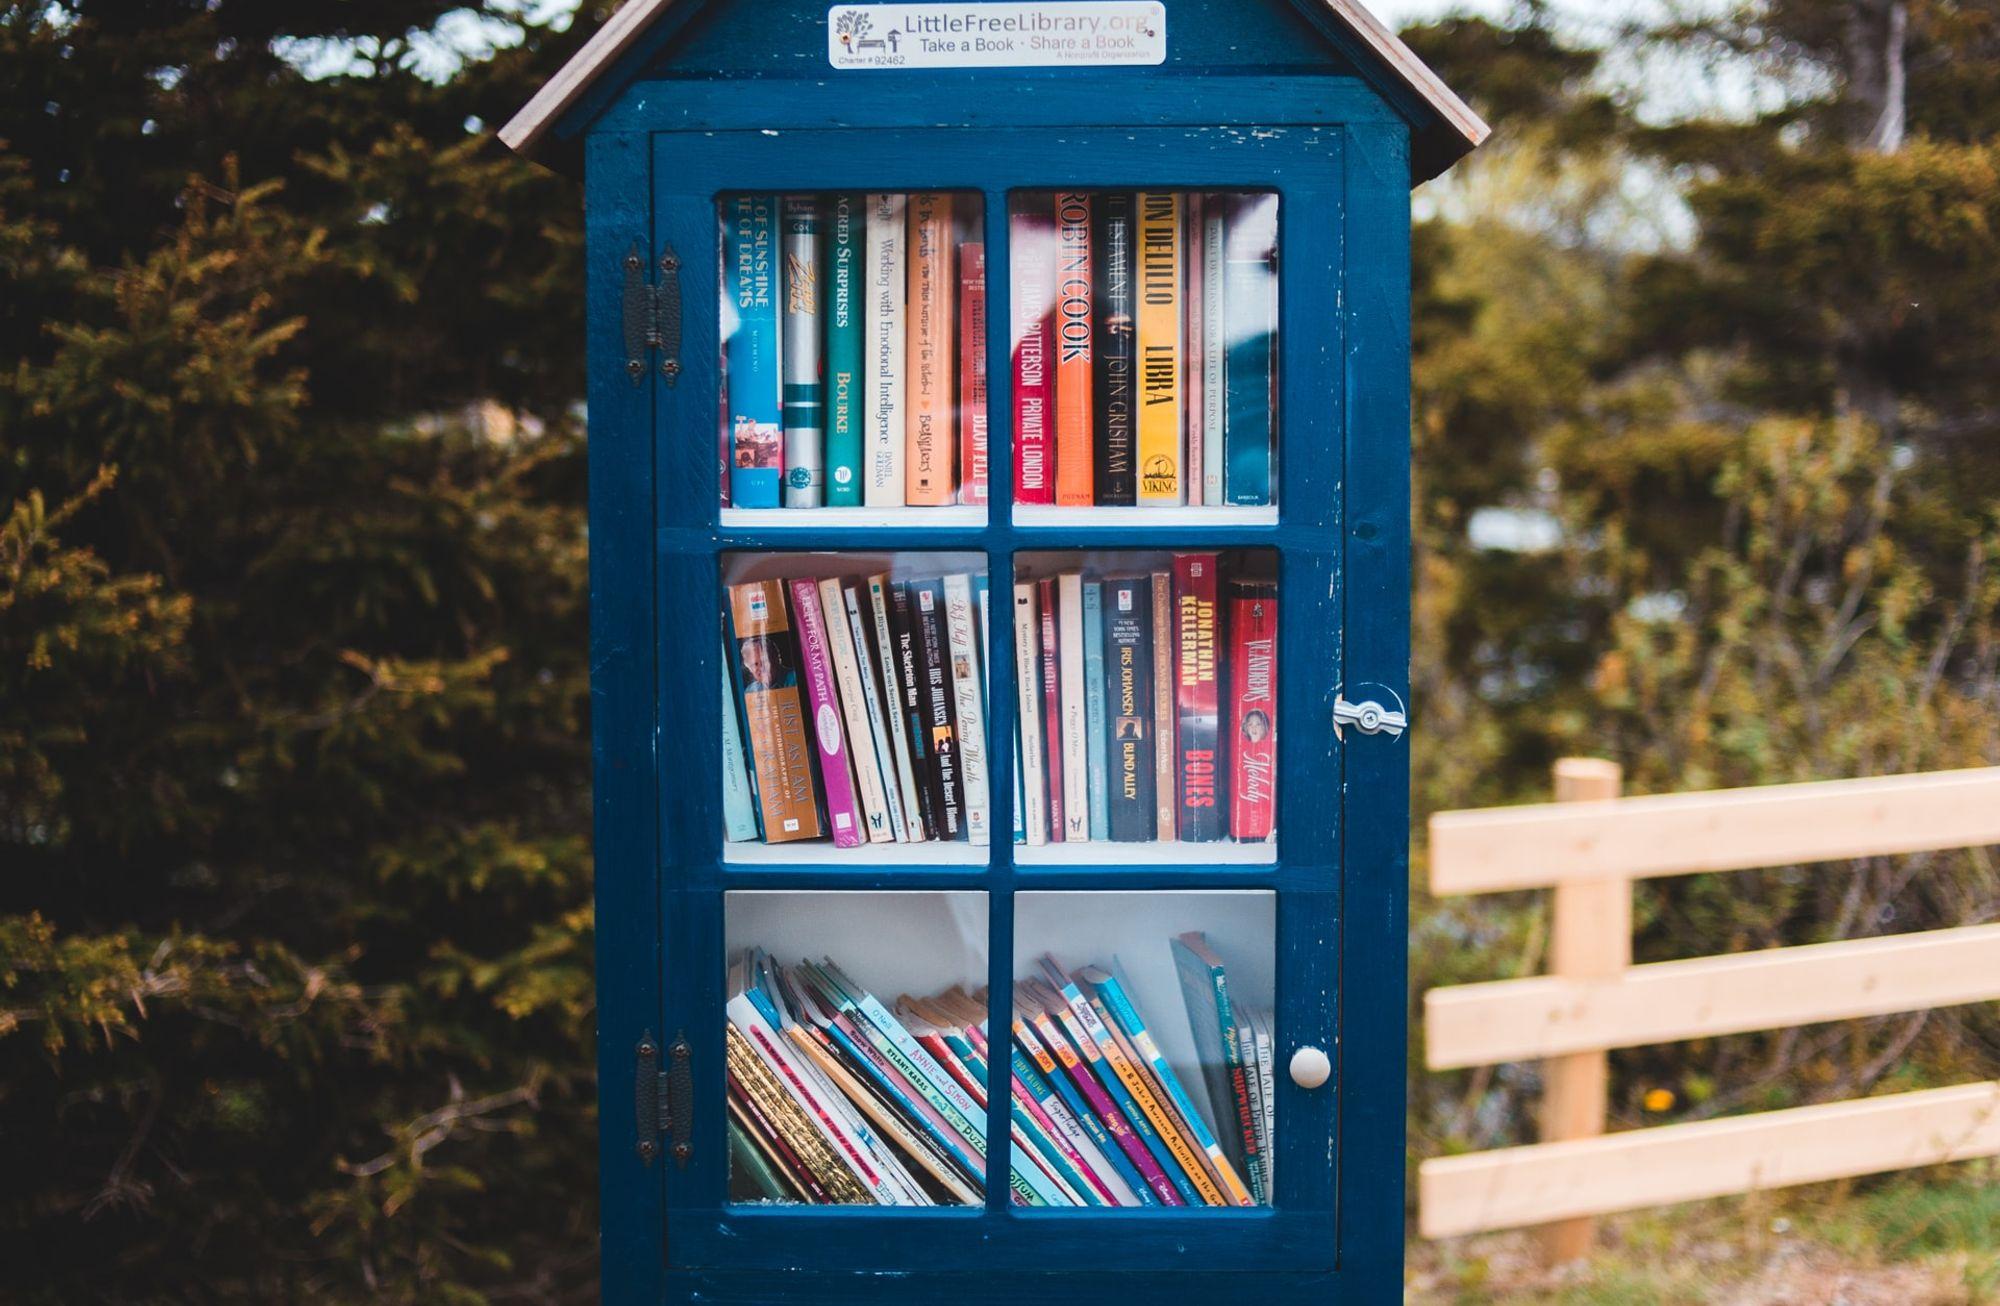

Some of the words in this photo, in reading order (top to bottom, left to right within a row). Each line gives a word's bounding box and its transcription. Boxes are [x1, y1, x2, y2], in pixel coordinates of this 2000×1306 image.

[905, 13, 1148, 34] LittleFreeLibrary.org
[838, 56, 867, 65] Charter
[874, 55, 905, 66] 92462
[920, 38, 955, 53] Take
[960, 42, 970, 52] a
[975, 36, 1014, 52] Book
[1030, 36, 1070, 50] Share
[1075, 40, 1085, 50] a
[1096, 35, 1135, 49] Book
[1060, 193, 1091, 273] ROBIN
[739, 243, 753, 308] DREAMS
[875, 239, 895, 287] Working
[1144, 228, 1174, 305] DELILLO
[836, 247, 852, 328] SURPRISES
[879, 290, 894, 317] with
[1060, 279, 1092, 364] COOK
[879, 321, 895, 379] Emotional
[1021, 321, 1043, 387] PATTERSON
[1104, 355, 1129, 396] JOHN
[1145, 346, 1174, 407] LIBRA
[836, 371, 852, 434] BOURKE
[875, 382, 894, 444] Intelligence
[1021, 398, 1043, 441] PRIVATE
[1109, 401, 1129, 473] GRISHAM
[1022, 443, 1043, 490] LONDON
[1142, 481, 1177, 493] VIKING
[806, 629, 819, 652] FOR
[899, 631, 912, 649] The
[1121, 646, 1133, 665] IRIS
[1182, 595, 1197, 686] KELLERMAN
[1198, 600, 1214, 681] JONATHAN
[810, 652, 822, 672] MY
[900, 649, 917, 687] Skeleton
[928, 666, 943, 685] IRIS
[813, 672, 828, 702] PATH
[907, 688, 918, 706] Man
[929, 685, 948, 726] JOHANSEN
[1121, 665, 1135, 715] JOHANSEN
[957, 710, 979, 744] Penny
[1123, 742, 1135, 770] BLIND
[942, 780, 956, 805] Desert
[1124, 771, 1136, 800] ALLEY
[1184, 750, 1214, 807] BONES
[1240, 751, 1272, 803] Melody
[1240, 1039, 1252, 1057] THE
[1258, 1044, 1270, 1066] THE
[908, 1046, 938, 1077] ANNIE
[943, 1082, 973, 1113] SIMON
[1244, 1063, 1257, 1089] TALE
[1261, 1072, 1273, 1100] TALE
[1232, 1067, 1257, 1155] SHIPWRECKED
[1248, 1091, 1259, 1106] OF
[1130, 1078, 1152, 1104] Jake's
[1146, 1102, 1174, 1137] Awesome
[1168, 1134, 1198, 1171] Activities
[1193, 1170, 1202, 1181] on
[1200, 1180, 1213, 1194] the
[1252, 1108, 1264, 1141] PETER
[1257, 1145, 1270, 1185] RABBIT
